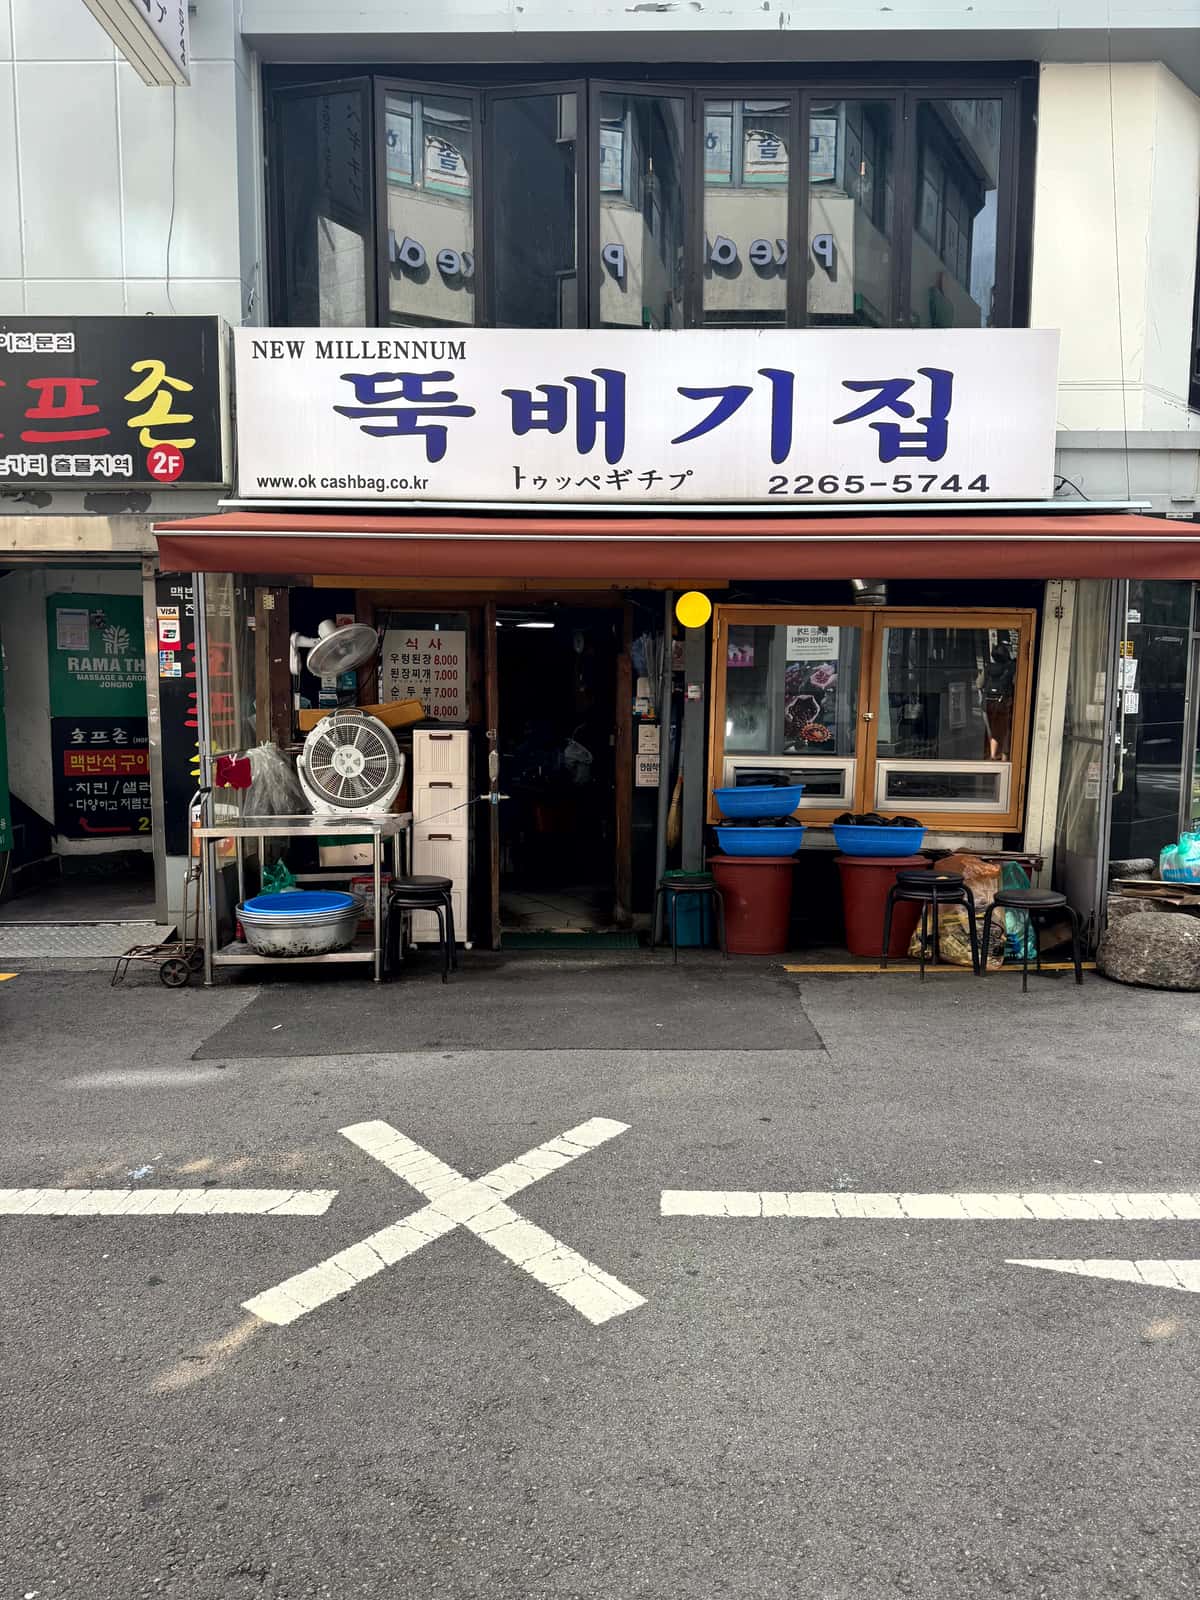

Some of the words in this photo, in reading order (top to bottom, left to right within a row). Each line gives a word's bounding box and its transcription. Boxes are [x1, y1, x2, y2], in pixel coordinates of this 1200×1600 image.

[252, 340, 305, 360] NEW
[316, 340, 467, 361] MILLENNUM
[0, 359, 196, 449] 프존
[333, 367, 954, 465] 뚝배기집
[153, 451, 180, 474] 2F
[768, 473, 990, 495] 2265-5744
[160, 607, 177, 615] VISA
[67, 657, 121, 672] RAMA
[124, 657, 146, 673] TH
[433, 654, 458, 665] 8,000
[76, 673, 115, 681] MASSAGE
[390, 668, 431, 680] 된장찌개
[433, 669, 458, 681] 7,000
[390, 686, 432, 697] 순두부
[433, 687, 458, 698] 7,000
[433, 705, 458, 717] 8,000
[71, 727, 128, 744] 호프존
[71, 754, 117, 772] 맥반석
[120, 753, 149, 772] 구이
[76, 781, 109, 795] 치킨
[138, 816, 150, 831] 2
